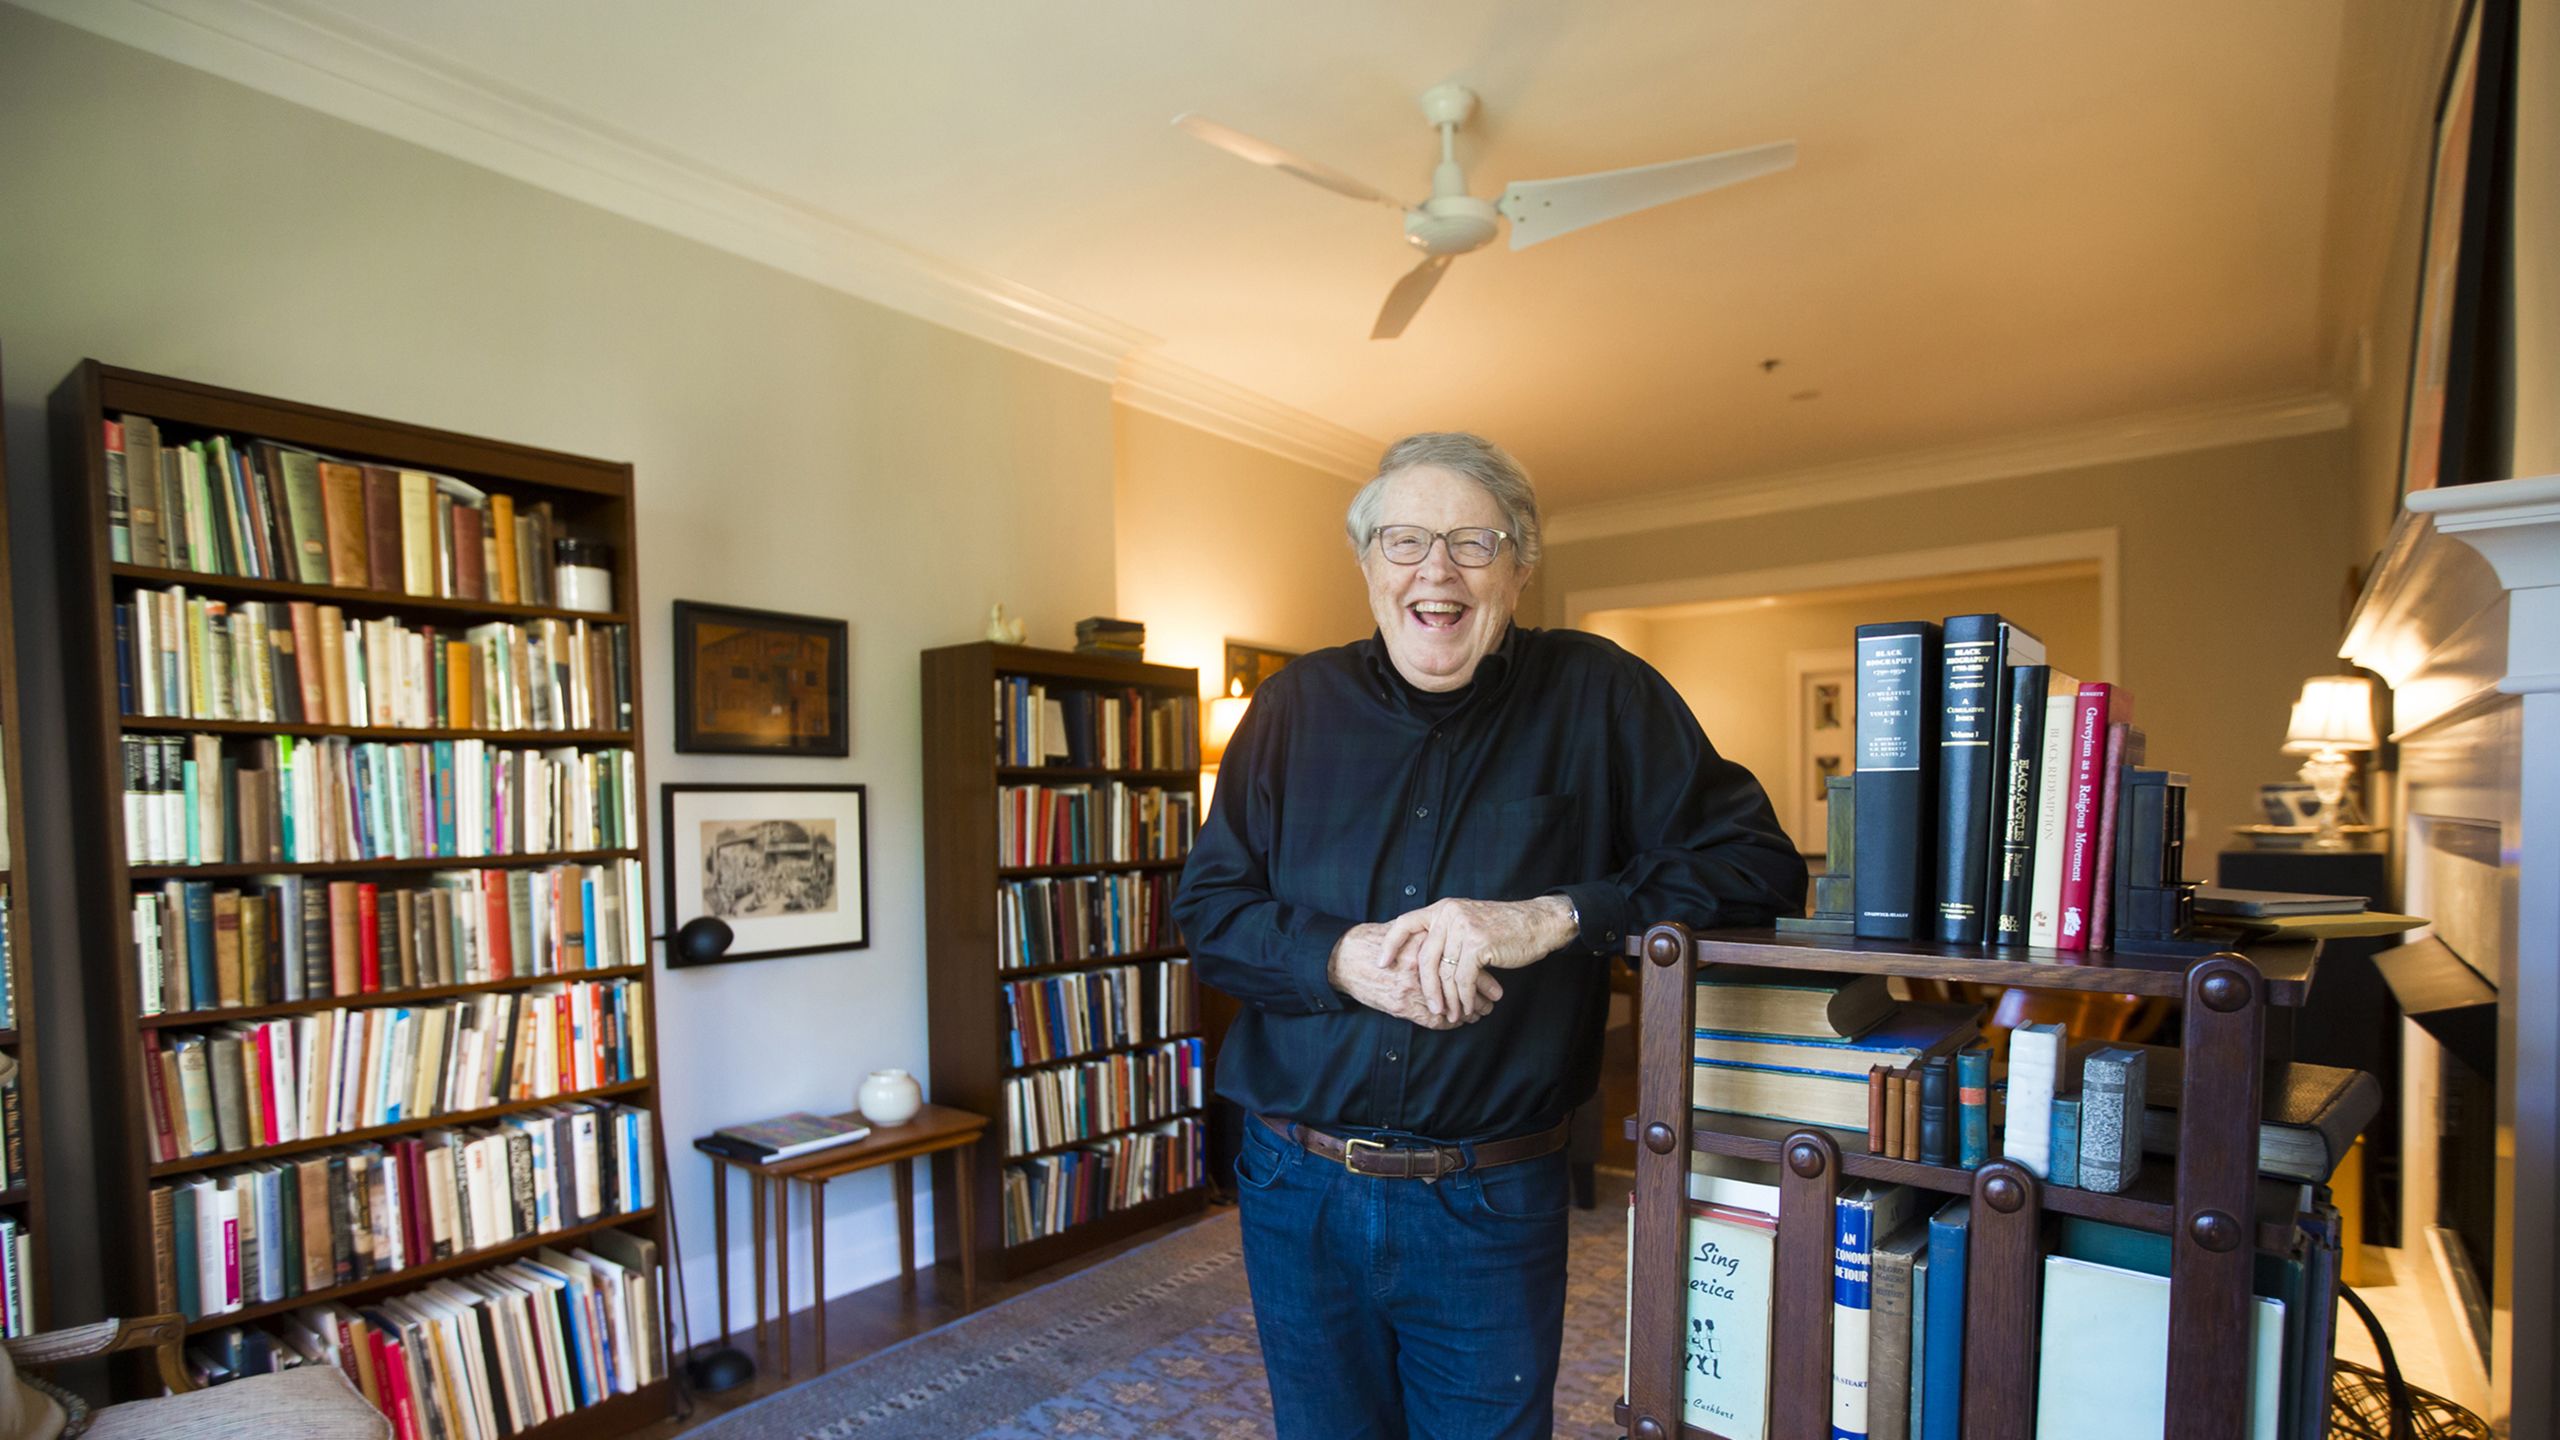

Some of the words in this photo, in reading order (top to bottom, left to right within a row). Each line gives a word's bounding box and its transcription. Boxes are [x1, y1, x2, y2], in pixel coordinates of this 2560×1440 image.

[1866, 657, 1913, 667] BIOGRAPHY
[1875, 649, 1902, 657] BLACK
[1946, 655, 1990, 664] BIOGRAPHY
[1955, 648, 1981, 656] BLACK
[1949, 681, 1985, 690] Supplement
[2081, 706, 2098, 757] Garveyism
[2046, 728, 2059, 765] BLACK
[2081, 759, 2090, 771] as
[2016, 759, 2030, 794] BLACK
[2043, 767, 2057, 840] REDEMPTION
[2075, 785, 2091, 829] Religious
[2013, 794, 2028, 842] APOSTLES
[2071, 832, 2087, 882] Movement
[1842, 1232, 1857, 1246] AN
[1694, 1243, 1739, 1276] Sing
[1690, 1279, 1734, 1300] erica
[1692, 1398, 1734, 1420] Cuthbert
